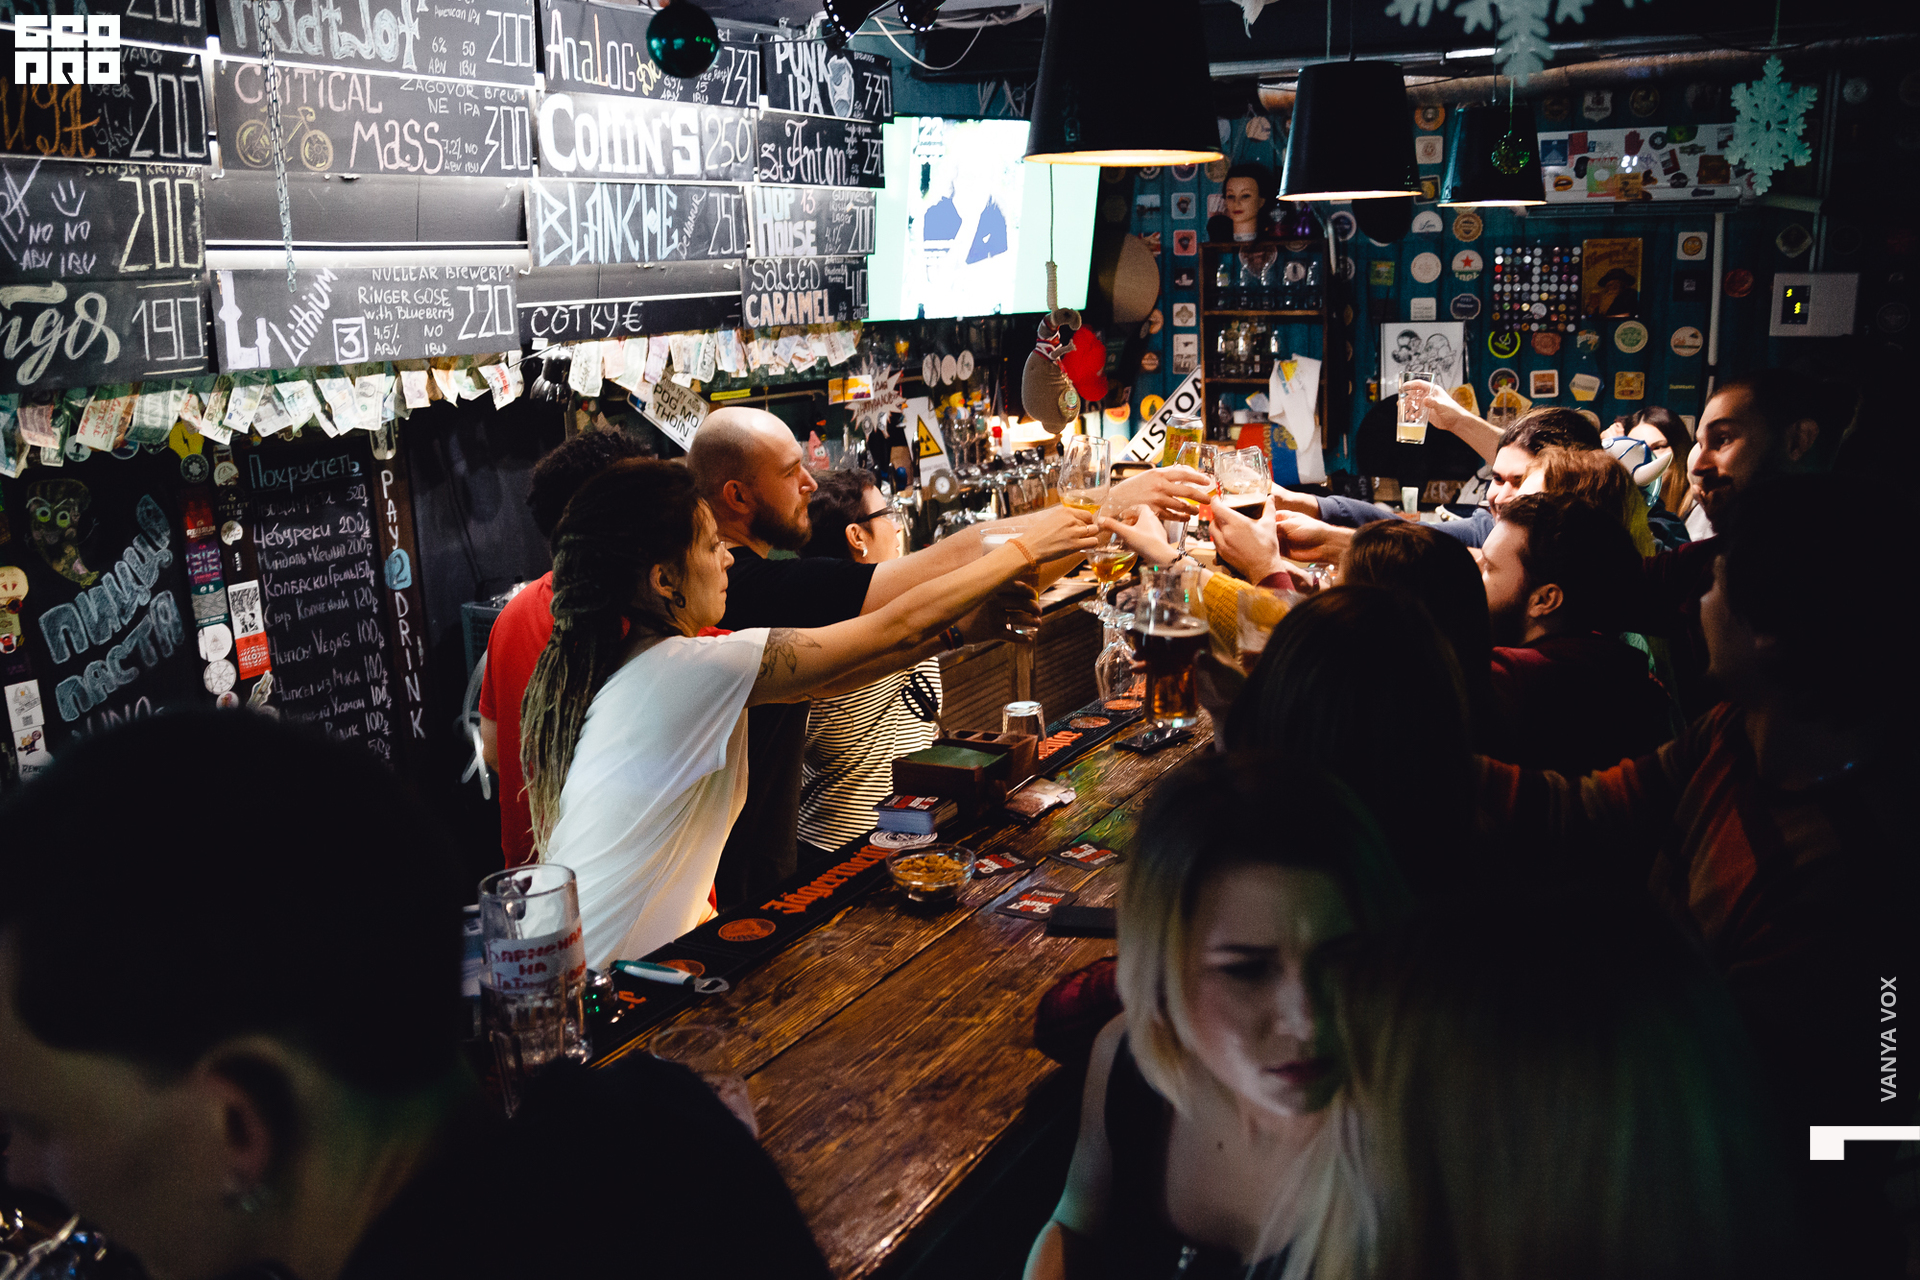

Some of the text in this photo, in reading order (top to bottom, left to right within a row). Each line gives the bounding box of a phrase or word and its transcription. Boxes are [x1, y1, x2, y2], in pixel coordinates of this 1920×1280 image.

[462, 40, 476, 57] 50
[486, 10, 534, 67] 200
[774, 34, 829, 82] PUNK
[129, 70, 207, 158] 200
[427, 97, 481, 117] NE IPA
[788, 73, 825, 115] IPA
[705, 113, 752, 170] 250
[29, 222, 53, 245] NO
[64, 220, 91, 244] NO
[118, 176, 204, 273] 200
[847, 205, 876, 254] 200
[745, 288, 835, 327] CARAMEL
[132, 296, 204, 362] 190
[373, 341, 403, 357] ABV
[424, 324, 443, 338] NO
[248, 453, 361, 493] Похрустеть
[253, 521, 331, 549] Чебуреки
